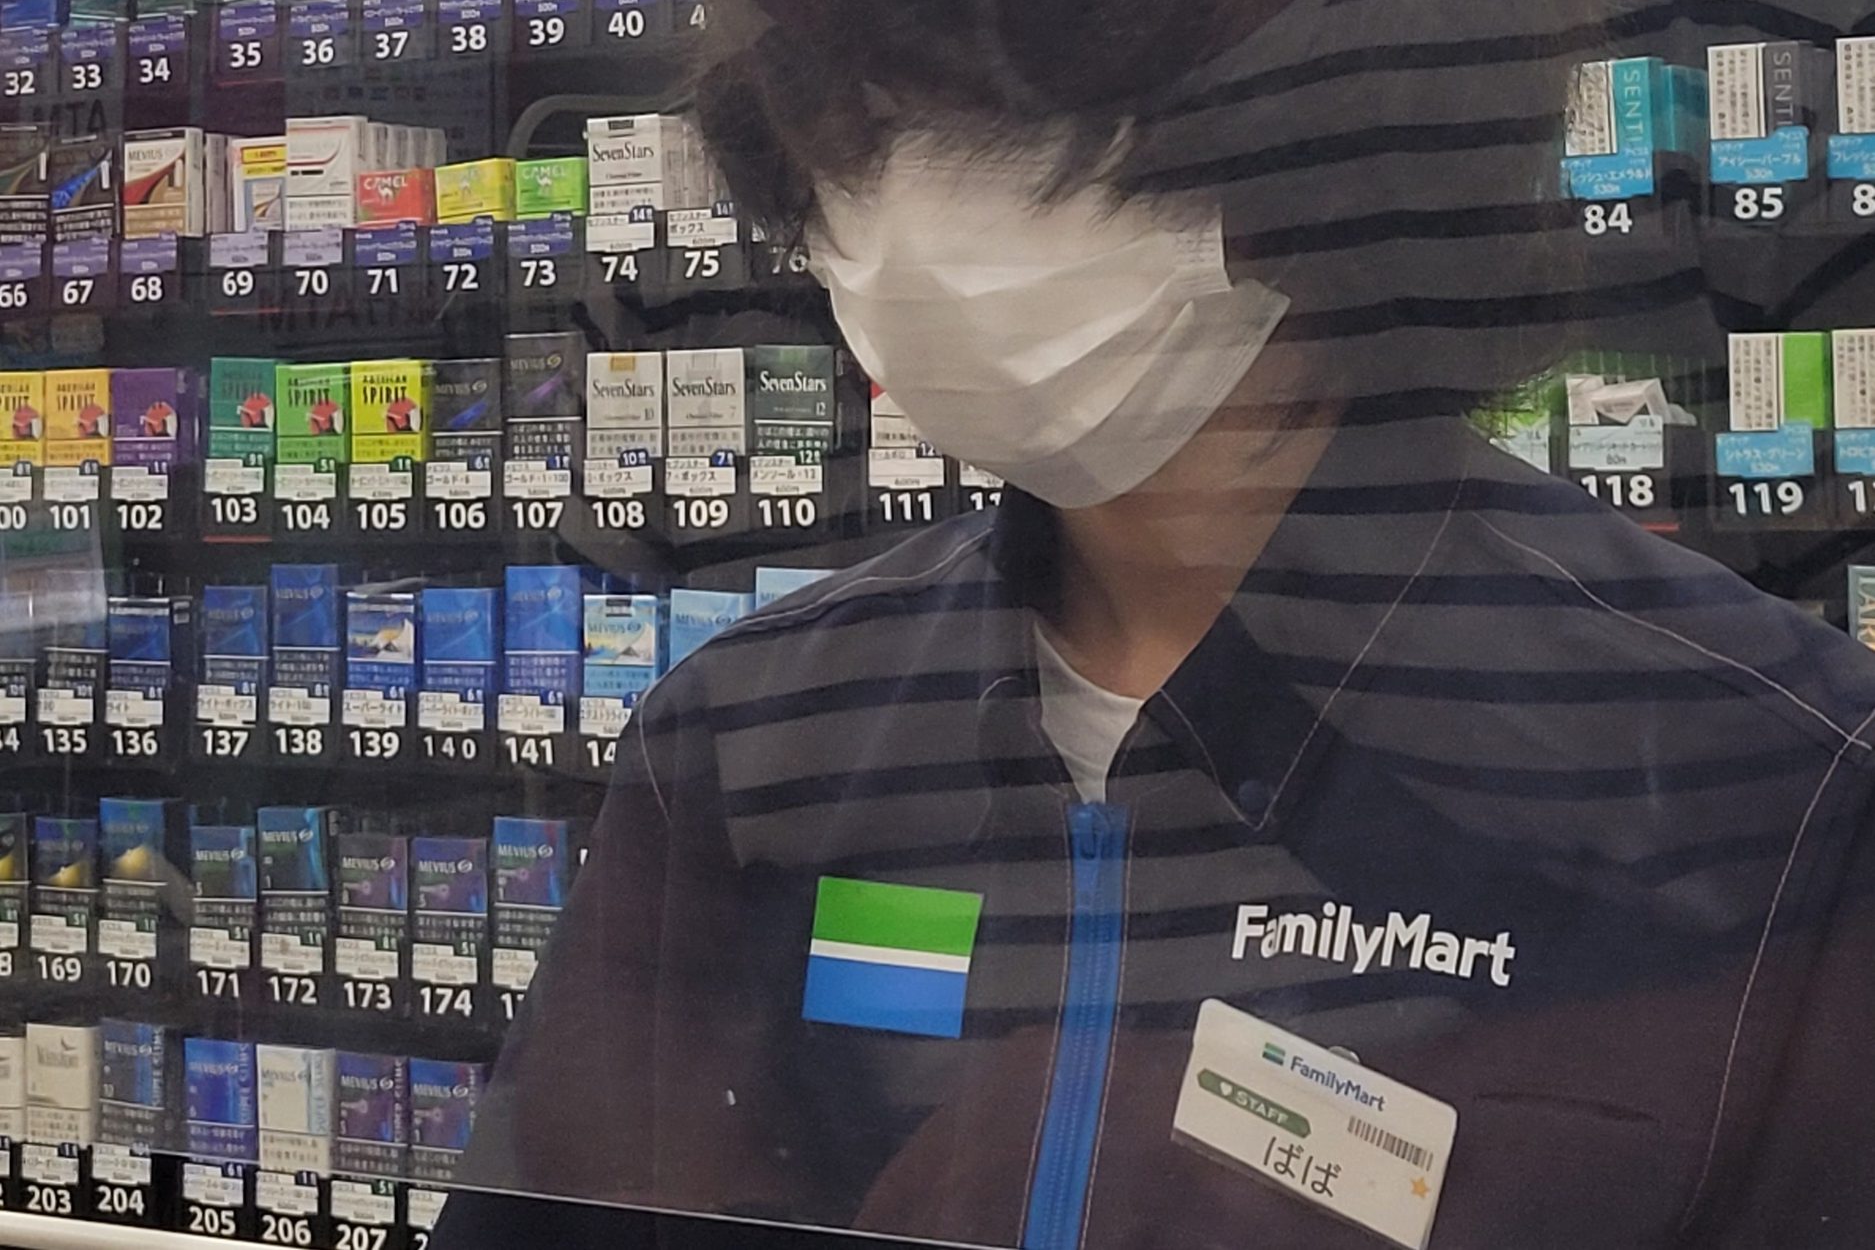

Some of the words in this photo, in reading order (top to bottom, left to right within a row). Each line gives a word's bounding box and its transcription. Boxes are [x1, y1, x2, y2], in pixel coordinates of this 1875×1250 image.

[529, 18, 565, 46] 39
[608, 10, 645, 38] 40
[302, 38, 335, 65] 36
[375, 31, 409, 59] 37
[451, 25, 487, 52] 38
[230, 42, 262, 68] 35
[5, 71, 35, 96] 32
[72, 64, 102, 90] 33
[139, 57, 171, 83] 34
[1734, 187, 1784, 220] 85
[1853, 183, 1875, 216] 8
[1584, 203, 1633, 235] 84
[443, 264, 479, 291] 72
[521, 259, 557, 287] 73
[602, 255, 638, 282] 74
[684, 250, 719, 278] 75
[63, 280, 94, 305] 67
[131, 276, 163, 301] 68
[222, 270, 254, 296] 69
[296, 269, 328, 295] 70
[367, 268, 398, 294] 71
[0, 283, 27, 308] 66
[288, 387, 331, 407] SPIRIT
[1581, 474, 1654, 507] 118
[1729, 481, 1804, 516] 119
[50, 504, 91, 530] 101
[117, 504, 163, 530] 102
[211, 498, 258, 524] 103
[282, 504, 331, 530] 104
[357, 502, 406, 530] 105
[434, 502, 486, 529] 106
[512, 501, 564, 529] 107
[592, 500, 645, 529] 108
[673, 499, 729, 528] 109
[758, 498, 816, 528] 110
[879, 492, 933, 522] 111
[43, 729, 88, 754] 135
[112, 730, 158, 755] 136
[203, 730, 249, 756] 137
[275, 729, 323, 755] 138
[349, 731, 400, 758] 139
[424, 736, 476, 759] 140
[505, 737, 554, 765] 141
[586, 741, 616, 767] 14
[1231, 901, 1516, 987] FamilyMart
[38, 956, 82, 982] 169
[106, 961, 151, 988] 170
[197, 969, 240, 998] 171
[268, 976, 317, 1005] 172
[344, 981, 392, 1010] 173
[420, 986, 473, 1017] 174
[1290, 1055, 1386, 1112] FamilyMart
[1235, 1089, 1289, 1125] STAFF
[1263, 1136, 1342, 1198] ばば
[27, 1185, 72, 1214] 203
[98, 1186, 145, 1216] 204
[189, 1205, 236, 1235] 205
[262, 1215, 312, 1245] 206
[336, 1224, 387, 1250] 207
